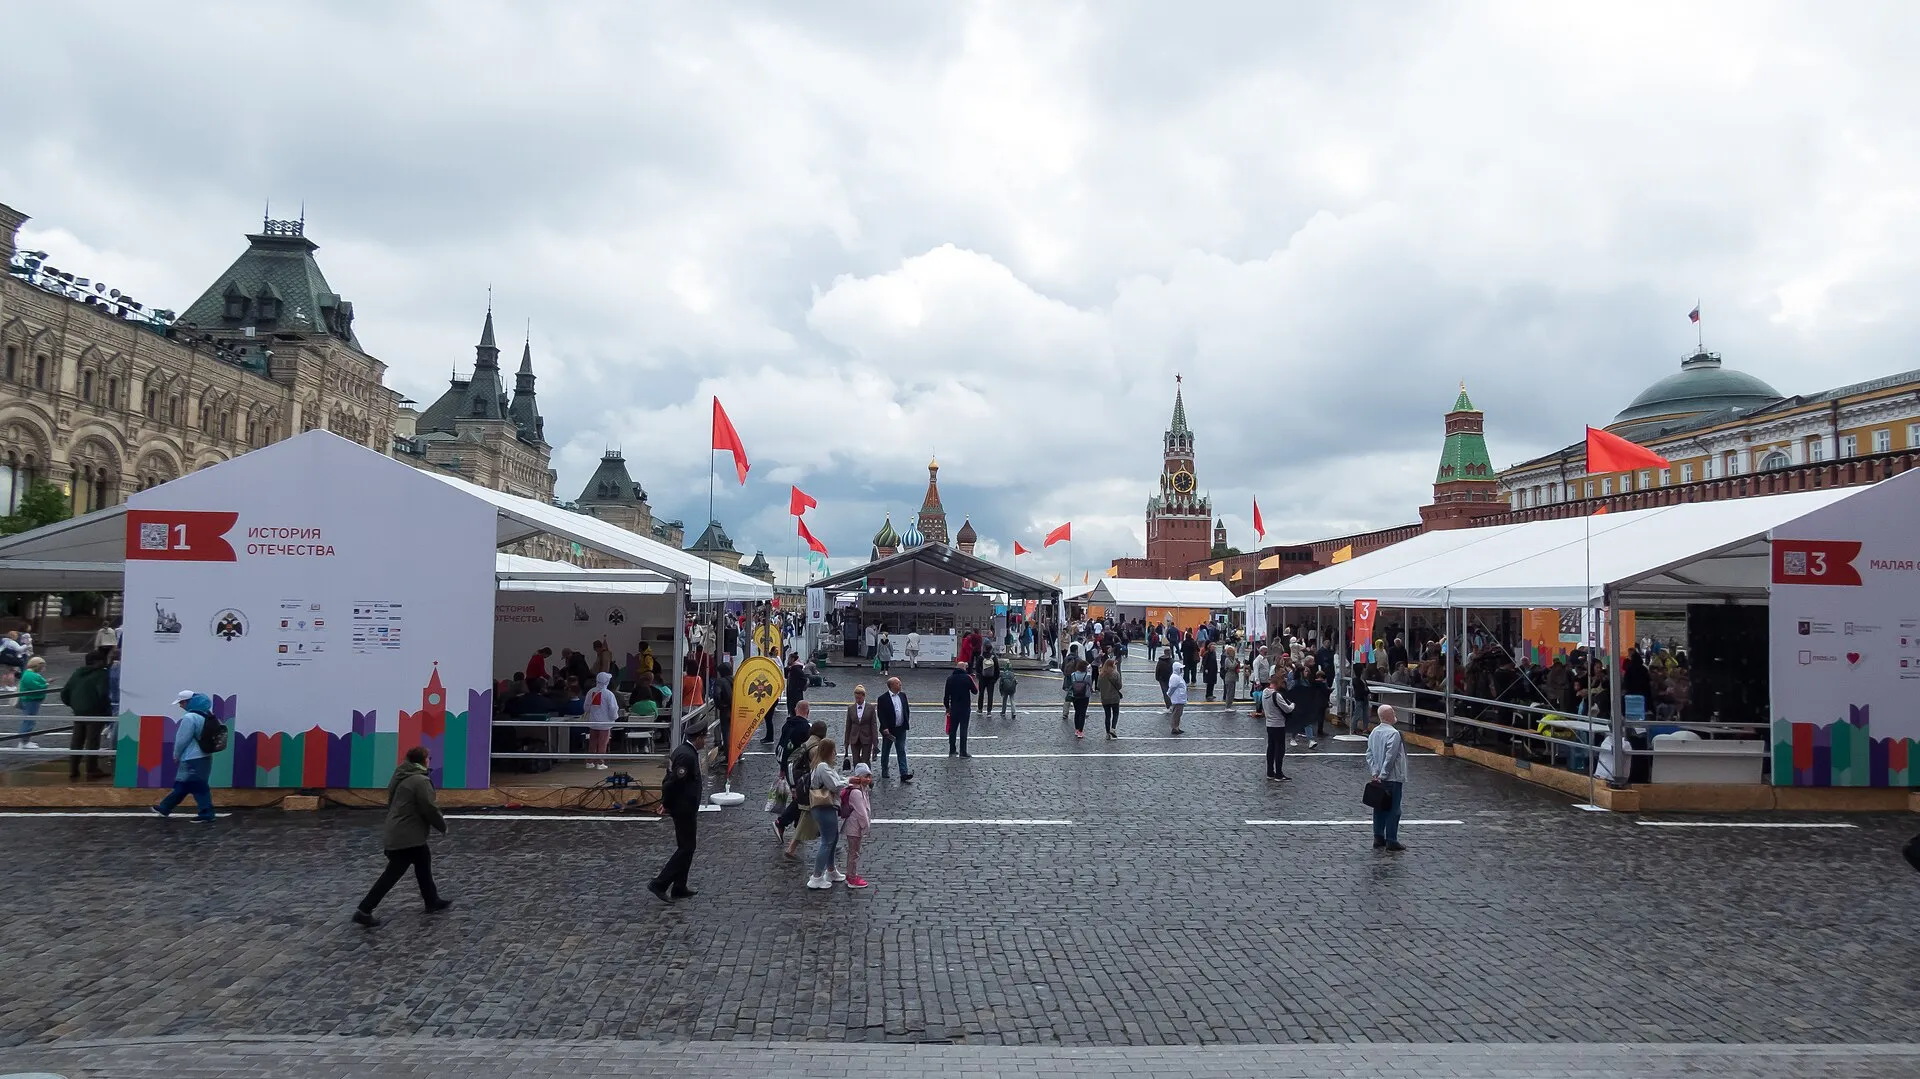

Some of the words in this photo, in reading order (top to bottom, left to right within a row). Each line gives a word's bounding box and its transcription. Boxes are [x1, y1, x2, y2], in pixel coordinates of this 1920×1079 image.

[173, 523, 191, 550] 1
[248, 527, 321, 540] ИСТОРИЯ
[246, 543, 335, 556] ОТЕЧЕСТВА
[1810, 551, 1827, 576] 3
[1870, 559, 1913, 570] МАЛАЯ
[1359, 602, 1370, 620] 3
[737, 707, 766, 751] ИСТОРИЯ.РФ
